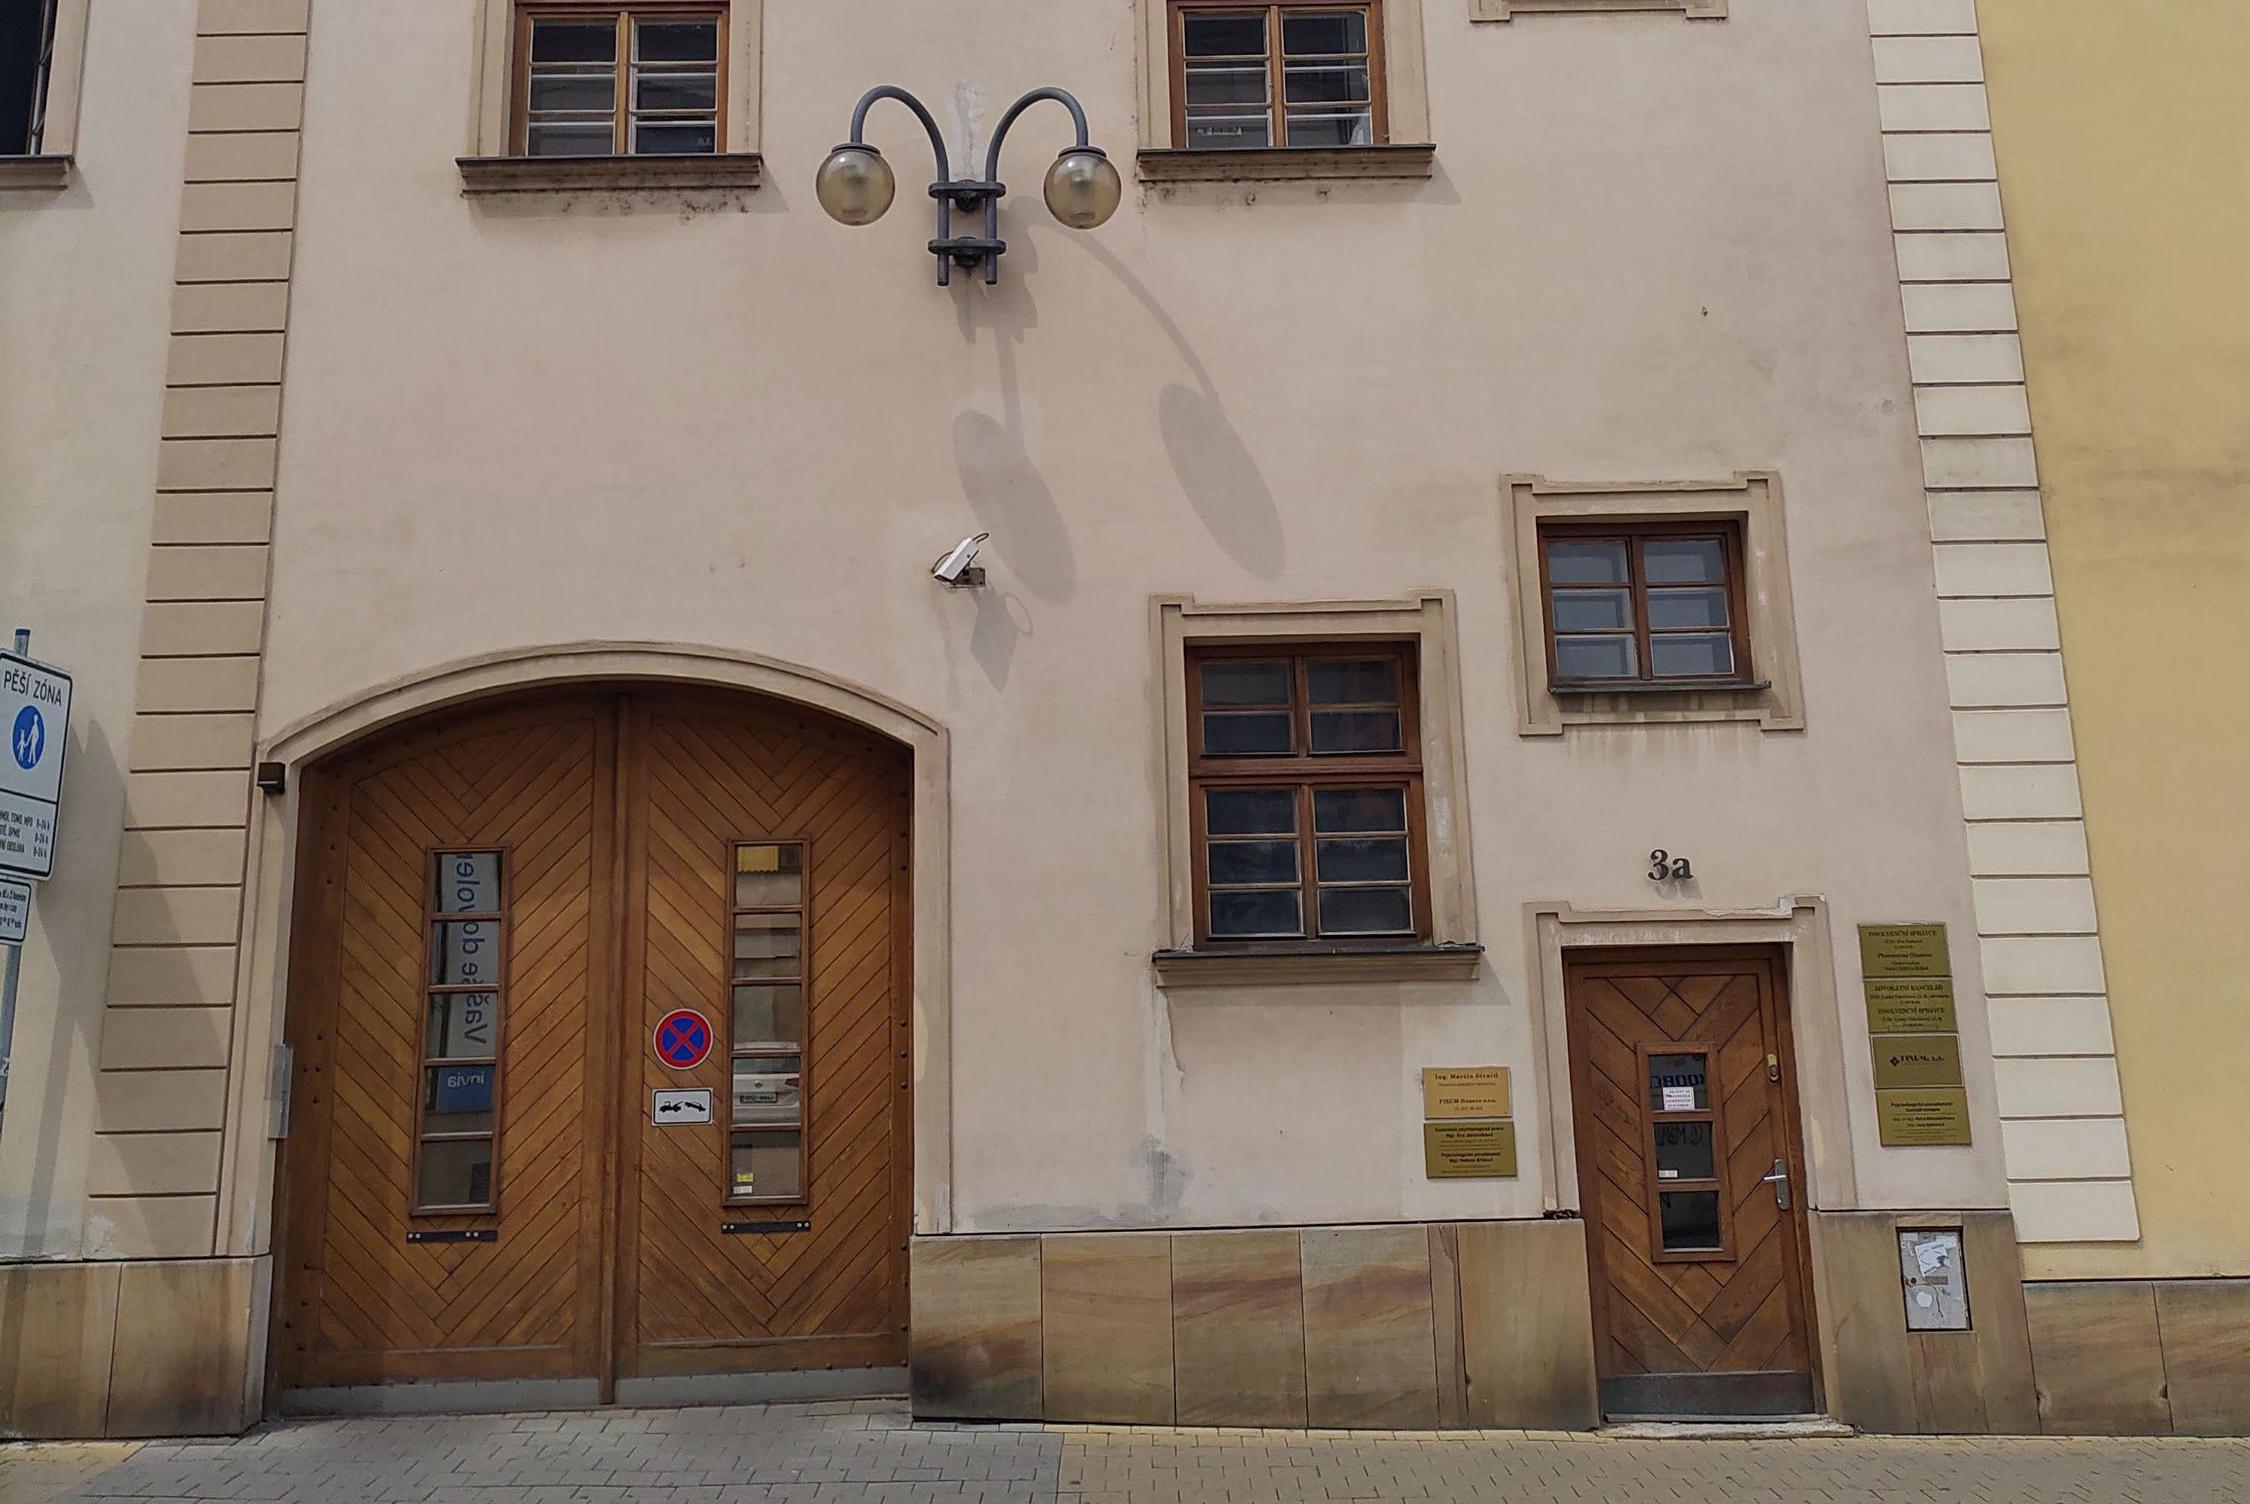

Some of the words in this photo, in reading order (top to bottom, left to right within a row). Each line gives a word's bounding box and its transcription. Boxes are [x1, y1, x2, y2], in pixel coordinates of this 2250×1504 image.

[4, 668, 32, 696] PĚŠÍ
[33, 678, 63, 707] ZÓNA
[1648, 849, 1694, 881] 3a
[1435, 1073, 1448, 1081] Ing.
